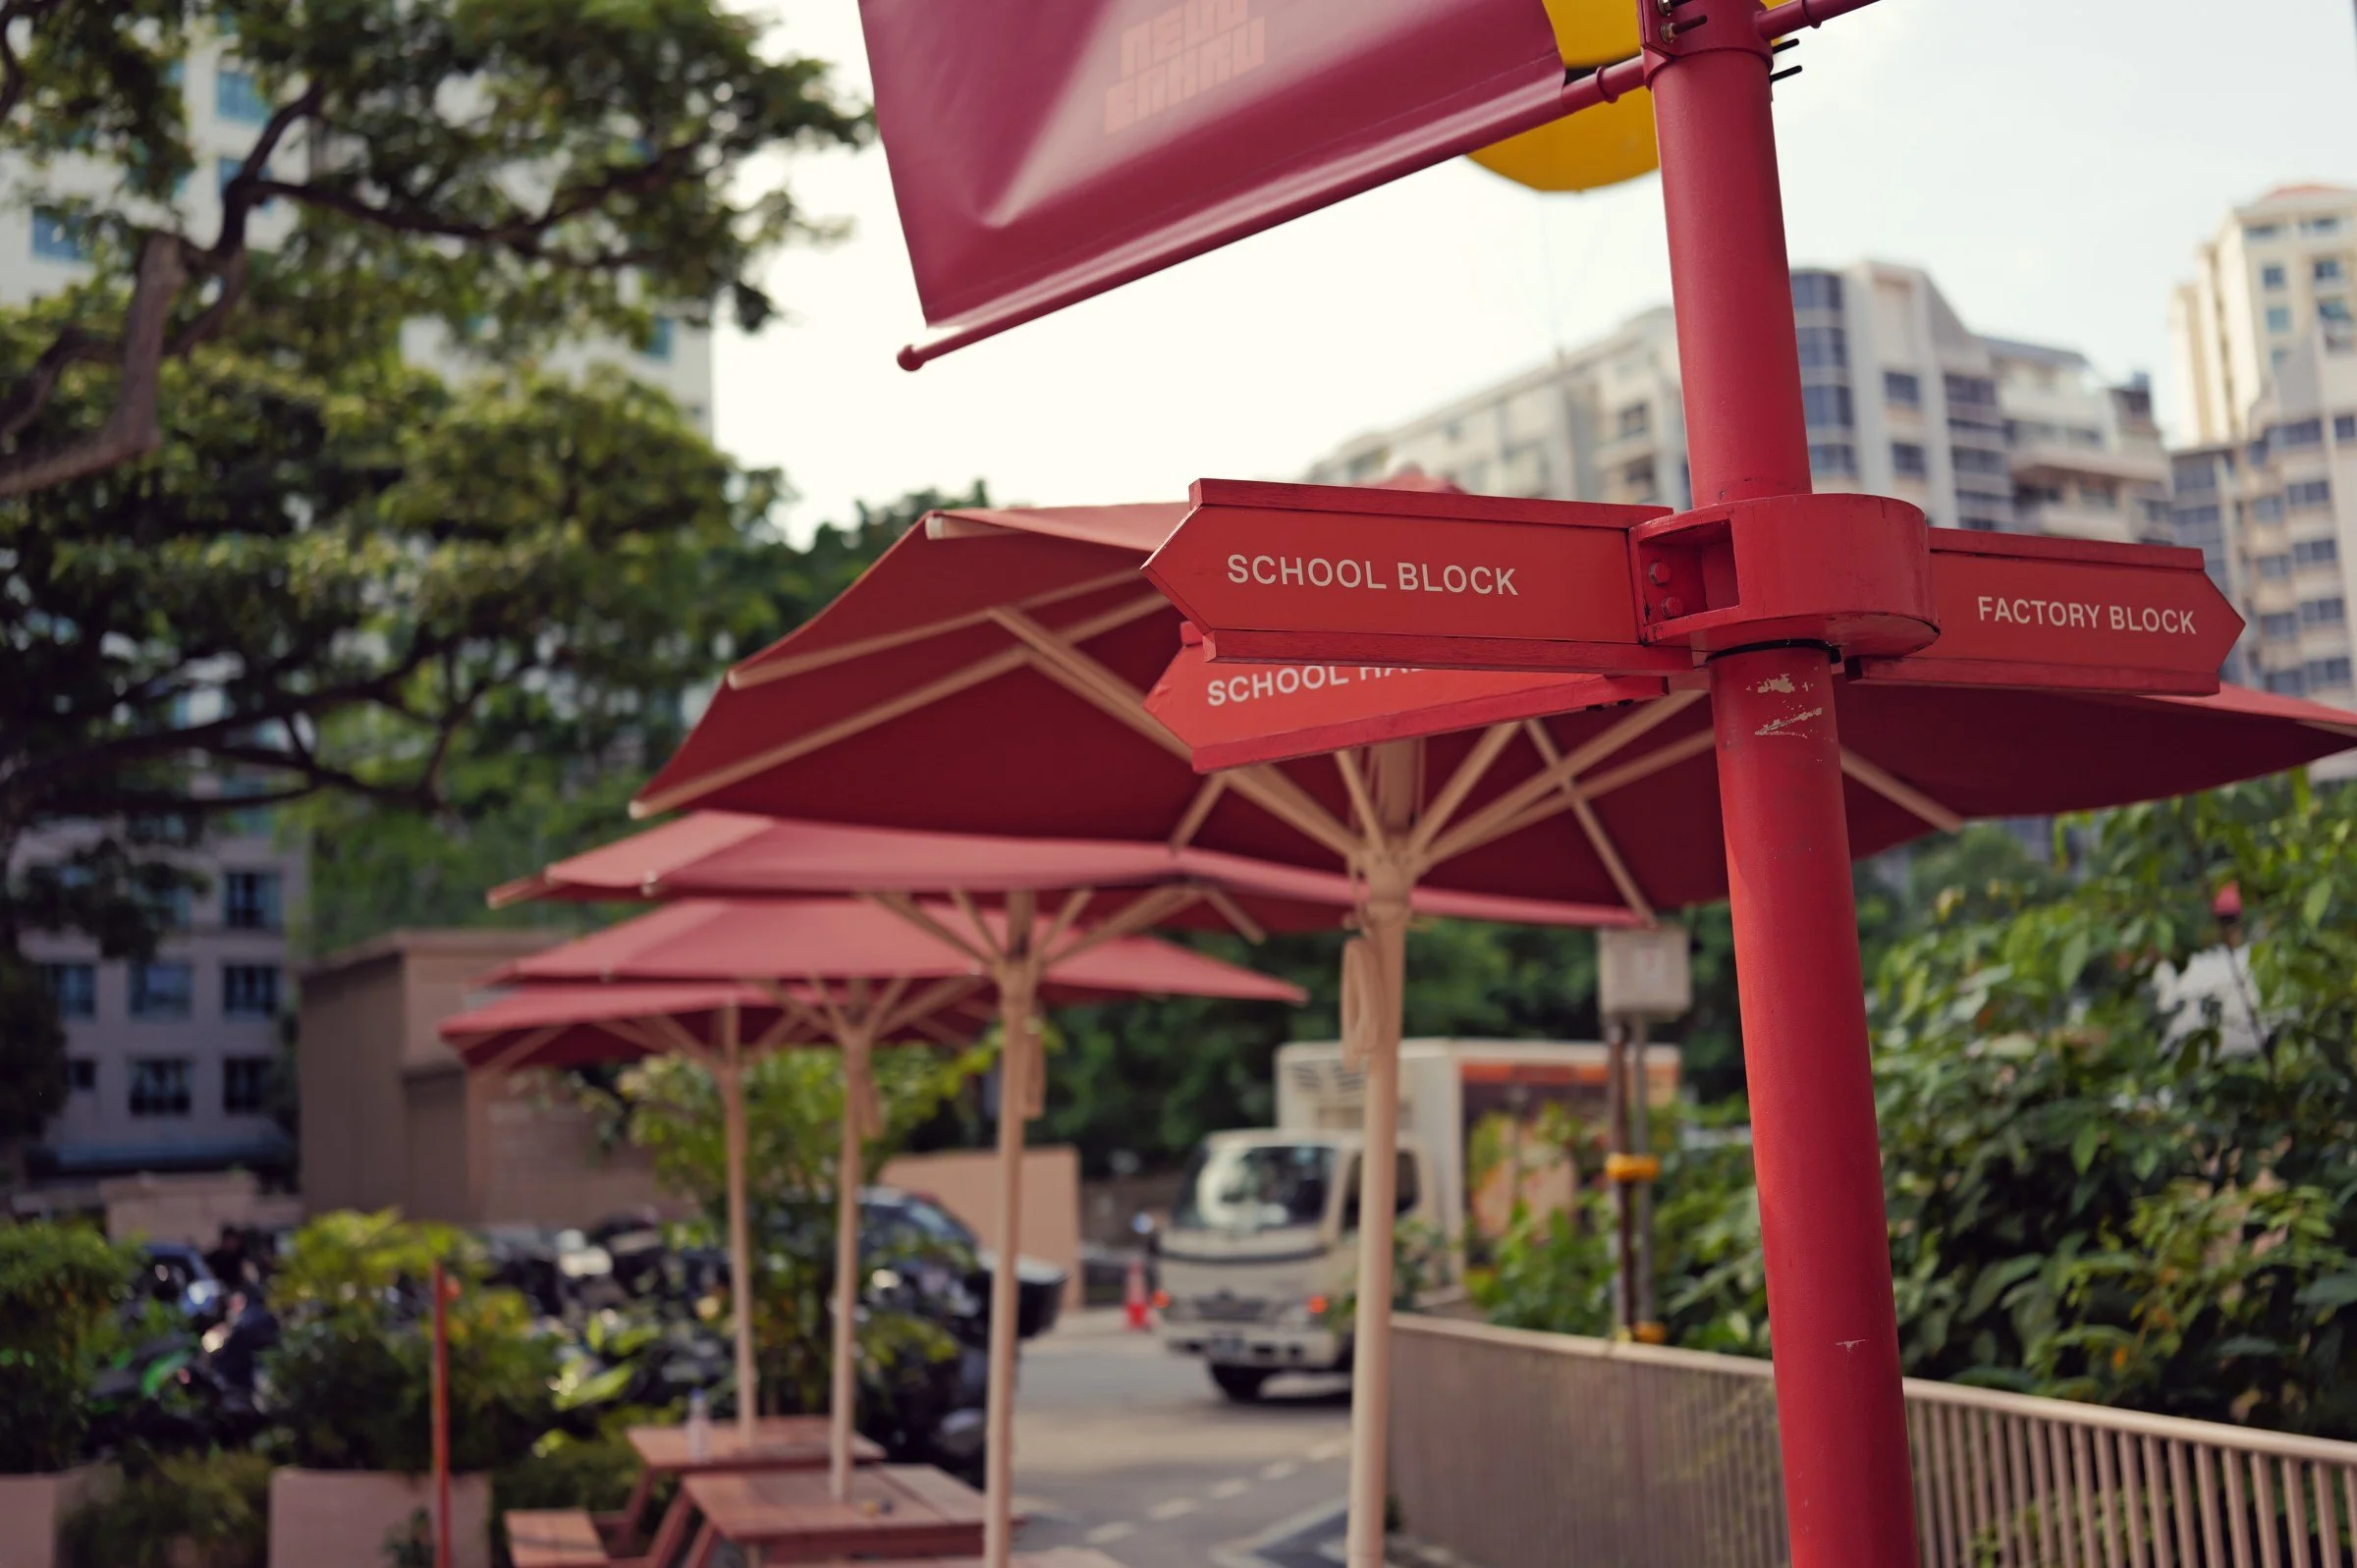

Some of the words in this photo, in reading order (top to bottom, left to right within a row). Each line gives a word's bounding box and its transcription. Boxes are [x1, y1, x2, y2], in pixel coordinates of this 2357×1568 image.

[1227, 554, 1387, 590] SCHOOL
[1397, 562, 1519, 596] BLOCK
[1978, 596, 2101, 629] FACTORY
[2110, 605, 2197, 635] BLOCK
[1207, 665, 1349, 707] SCHOOL
